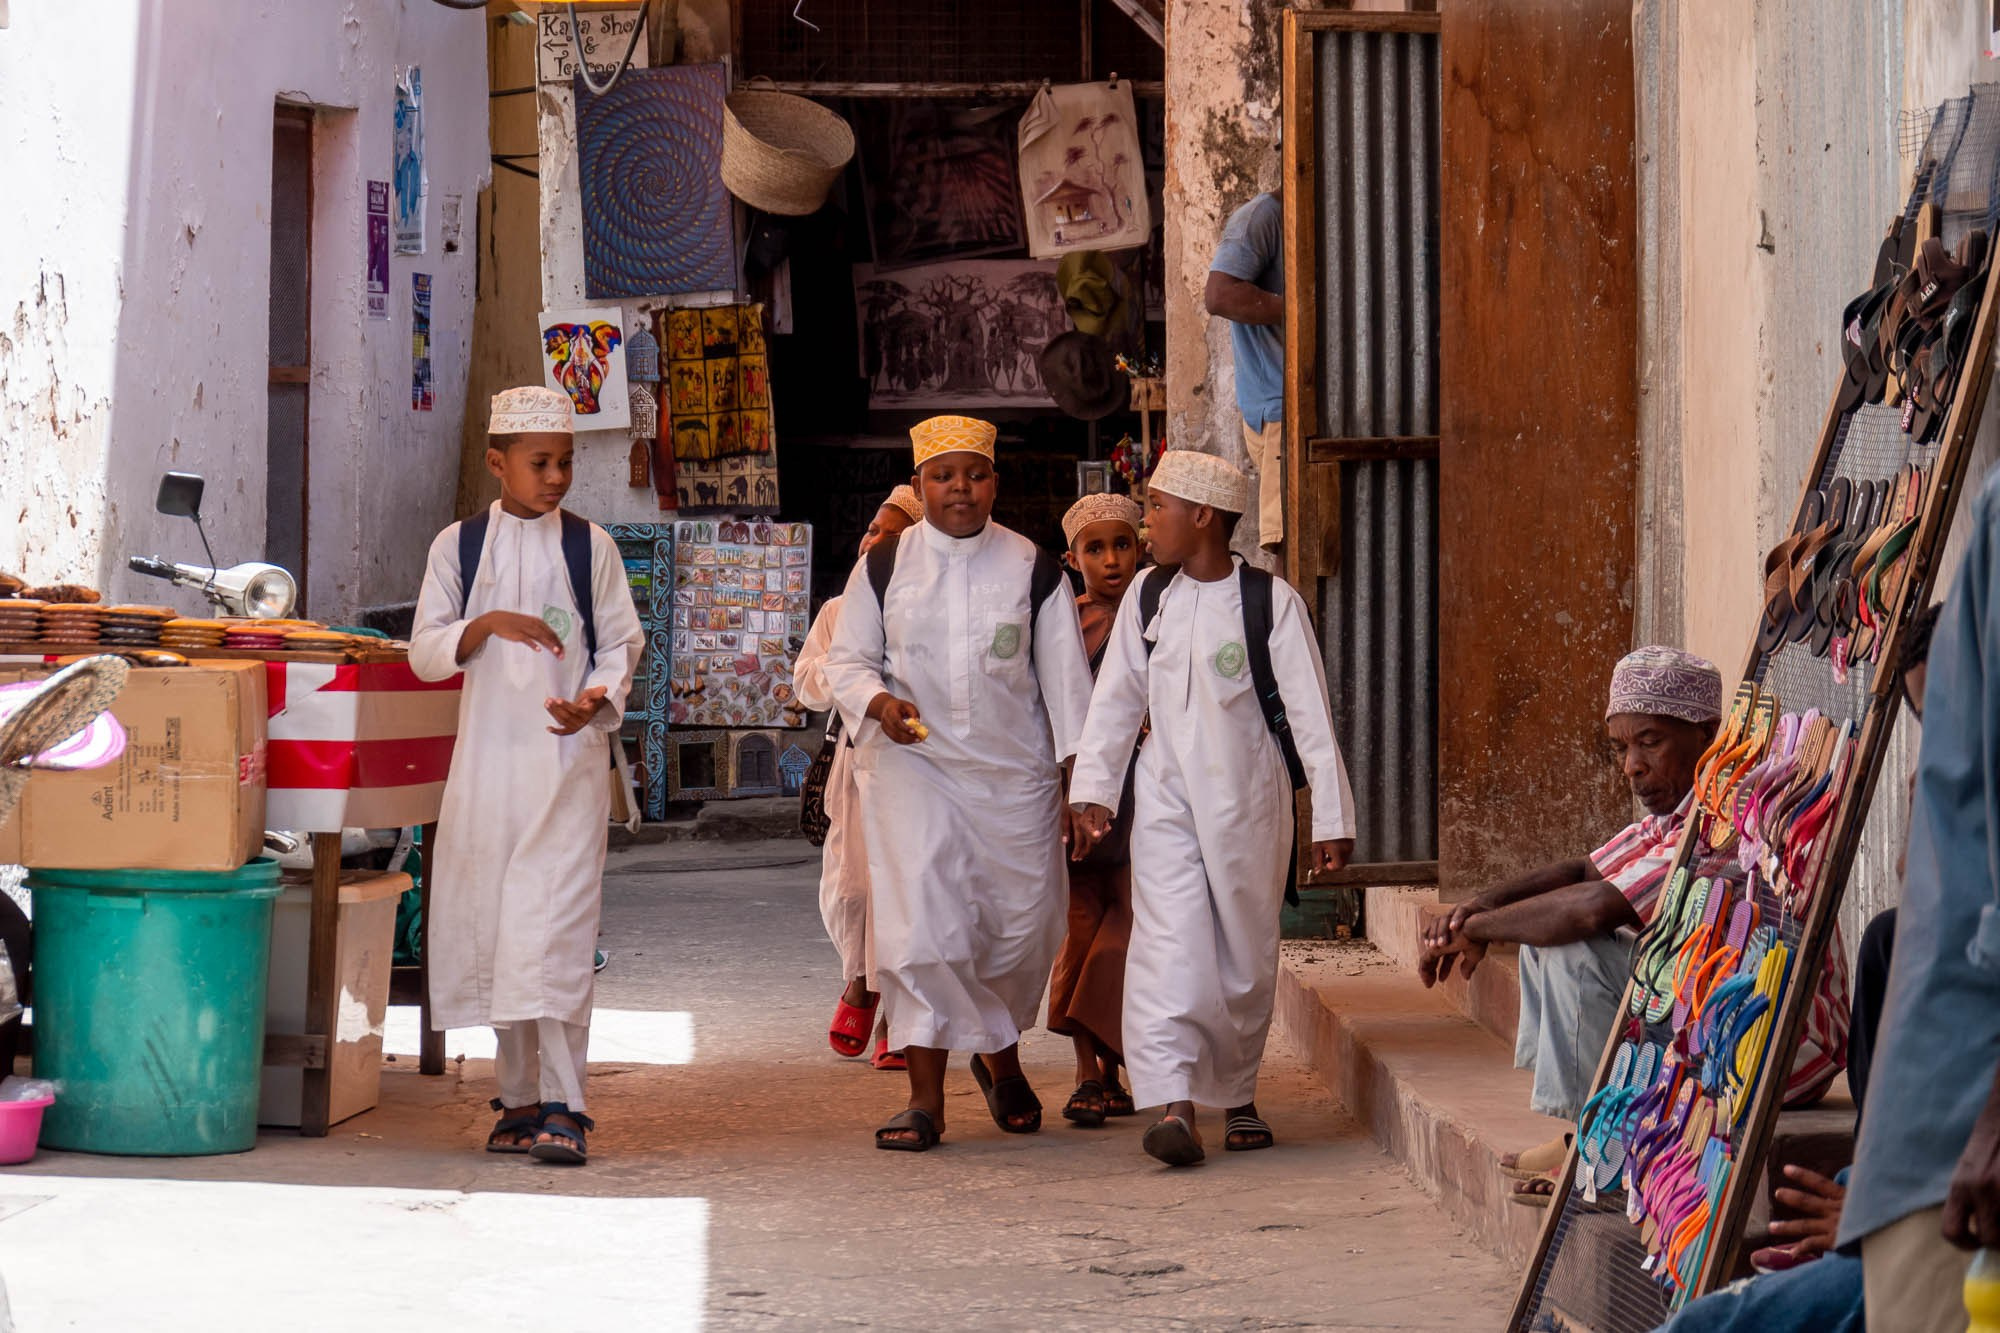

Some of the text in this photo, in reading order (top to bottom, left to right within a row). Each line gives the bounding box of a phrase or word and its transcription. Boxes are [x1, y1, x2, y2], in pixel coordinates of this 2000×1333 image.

[600, 13, 640, 35] Sho
[584, 36, 600, 54] &
[101, 785, 113, 821] Adent
